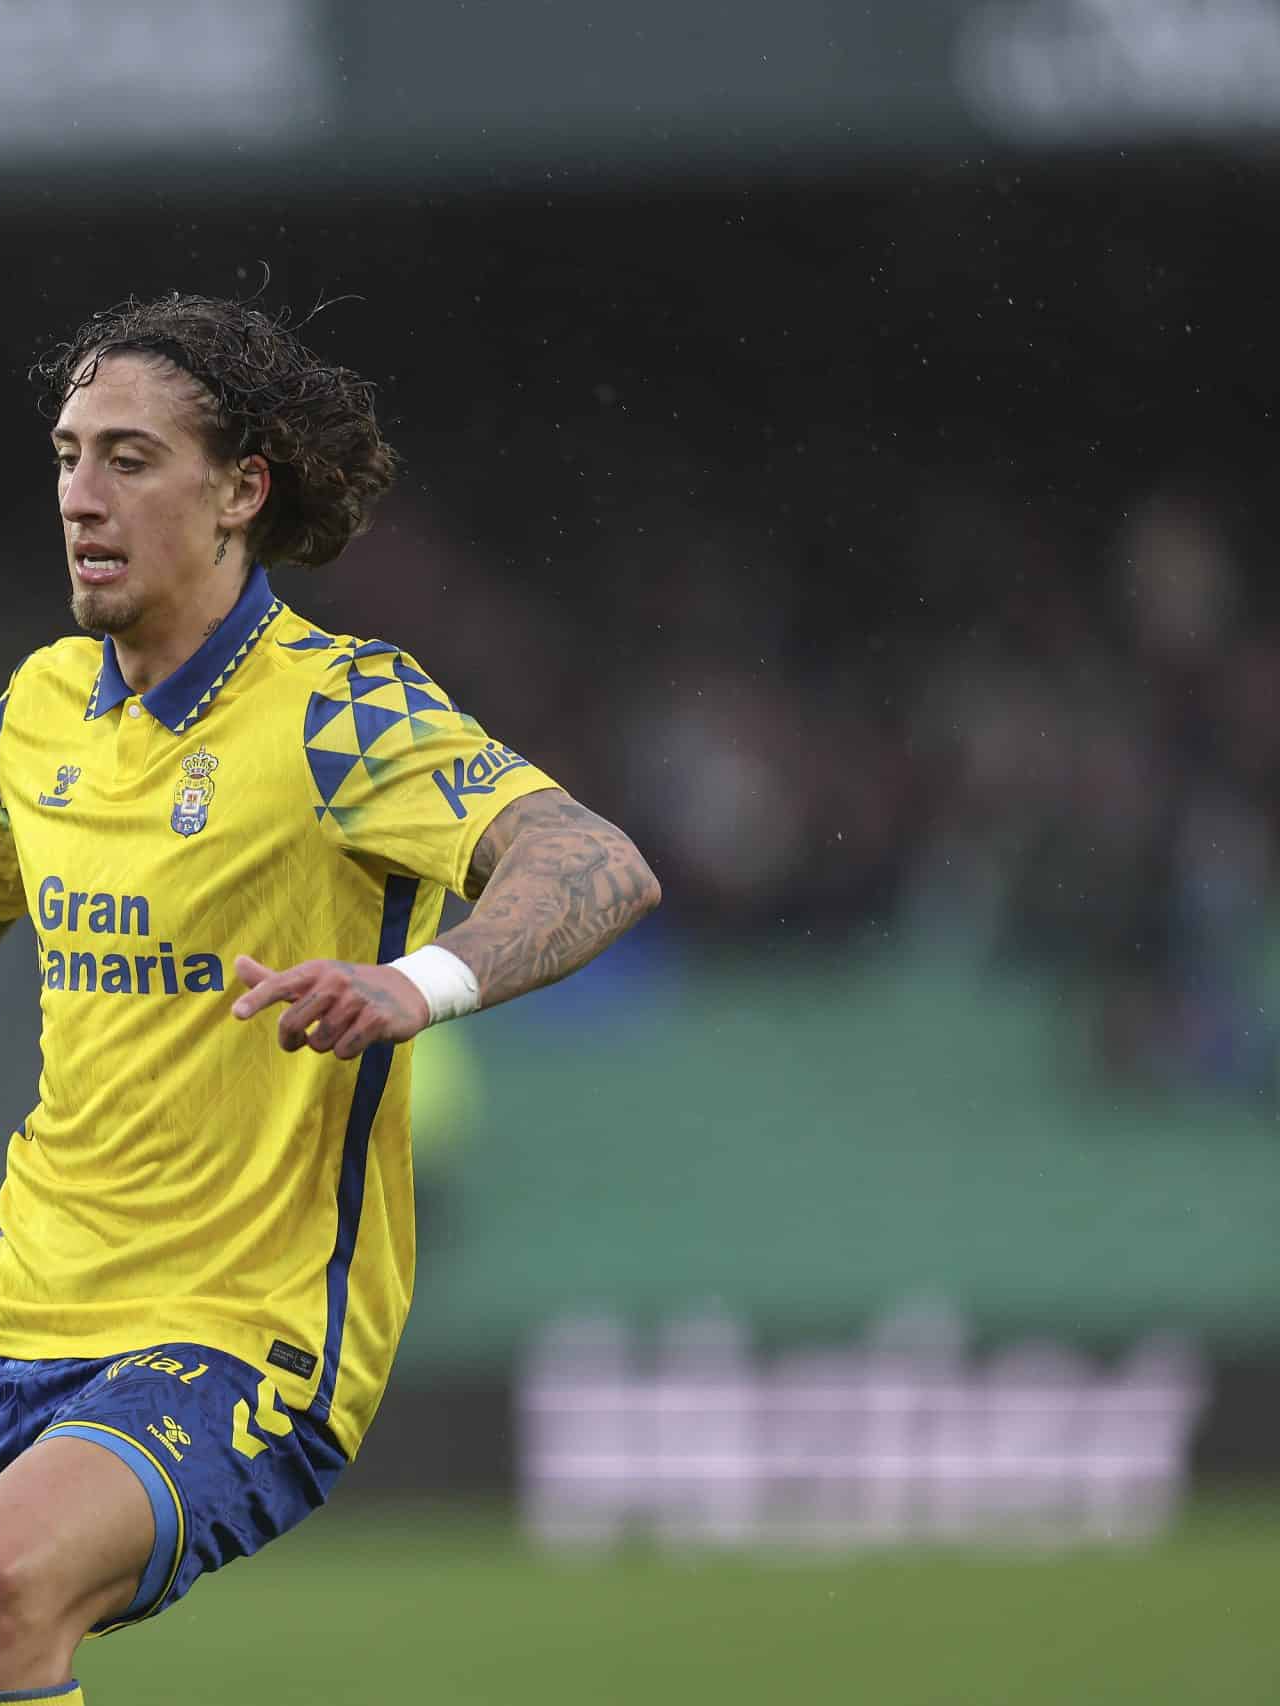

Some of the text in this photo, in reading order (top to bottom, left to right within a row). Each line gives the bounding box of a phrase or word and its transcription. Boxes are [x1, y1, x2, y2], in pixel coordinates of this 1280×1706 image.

[432, 742, 528, 819] Kalis
[38, 876, 149, 936] Gran
[38, 938, 225, 995] anaria
